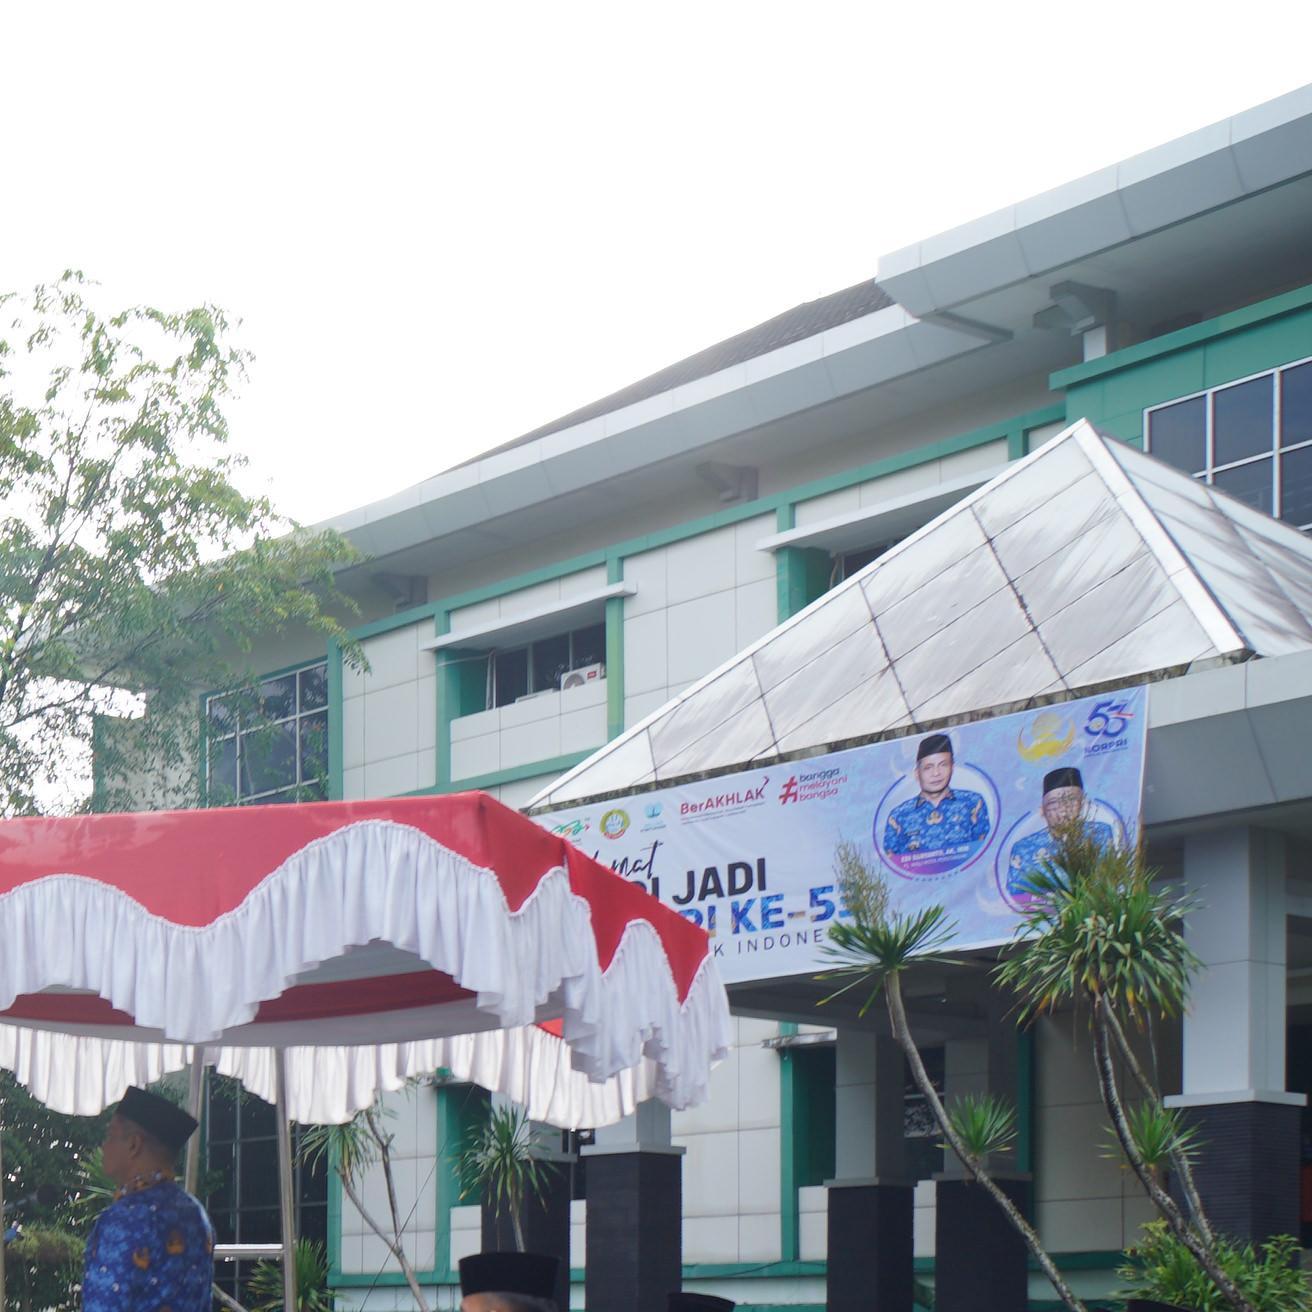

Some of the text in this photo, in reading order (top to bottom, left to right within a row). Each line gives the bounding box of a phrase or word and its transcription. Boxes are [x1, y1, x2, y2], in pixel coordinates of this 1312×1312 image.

[800, 768, 840, 782] bangga
[800, 776, 848, 792] melayani
[680, 778, 768, 815] BerAKHLAK
[800, 788, 839, 801] bangsa
[672, 857, 767, 905] JADI
